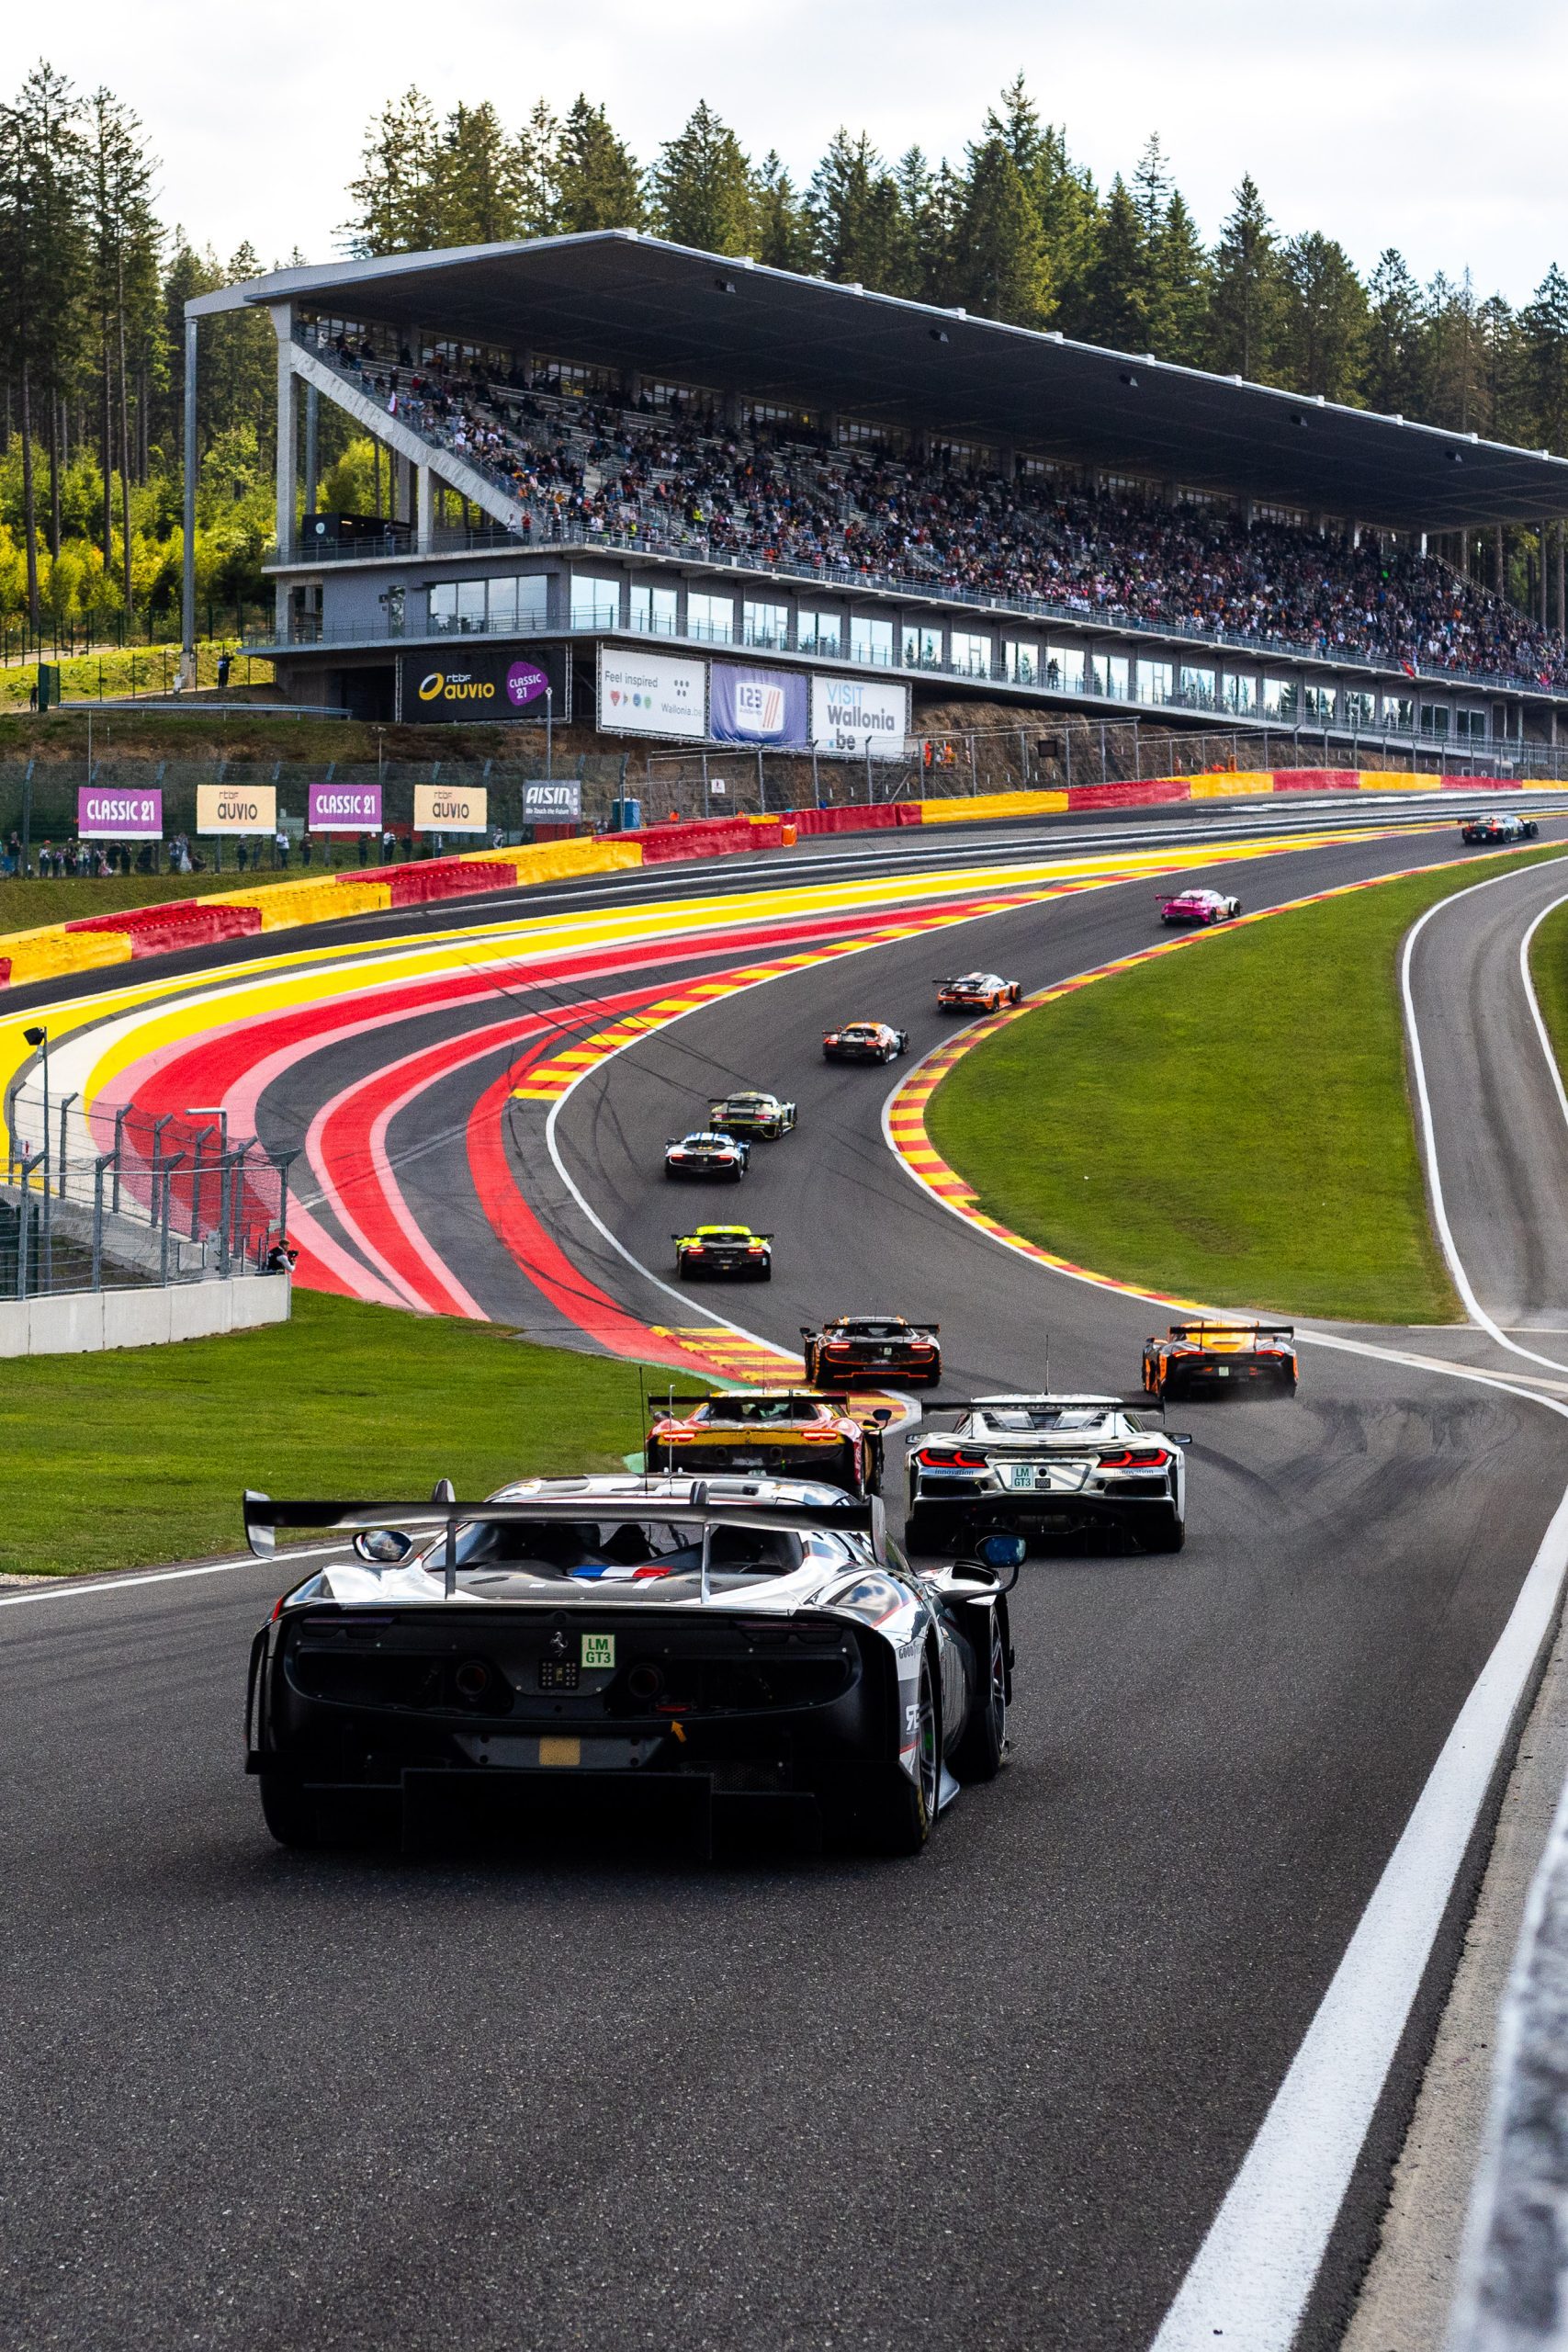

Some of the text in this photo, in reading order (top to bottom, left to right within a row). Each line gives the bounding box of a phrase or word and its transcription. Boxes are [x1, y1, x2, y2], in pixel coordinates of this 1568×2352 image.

[509, 673, 542, 688] CLASSIC
[604, 670, 659, 688] Feel inspired
[445, 683, 495, 699] auvio
[516, 687, 527, 699] 21
[740, 686, 762, 708] 123
[827, 683, 864, 706] VISIT
[828, 705, 895, 731] Wallonia
[525, 786, 570, 805] AISIN
[86, 799, 154, 821] CLASSIC 21
[217, 803, 258, 820] auvio
[316, 795, 376, 814] CLASSIC 21
[433, 802, 469, 819] auvio
[935, 1467, 975, 1476] innovation
[1016, 1468, 1030, 1477] LM
[1014, 1477, 1031, 1487] GT3
[588, 1638, 609, 1651] LM
[585, 1651, 612, 1664] GT3
